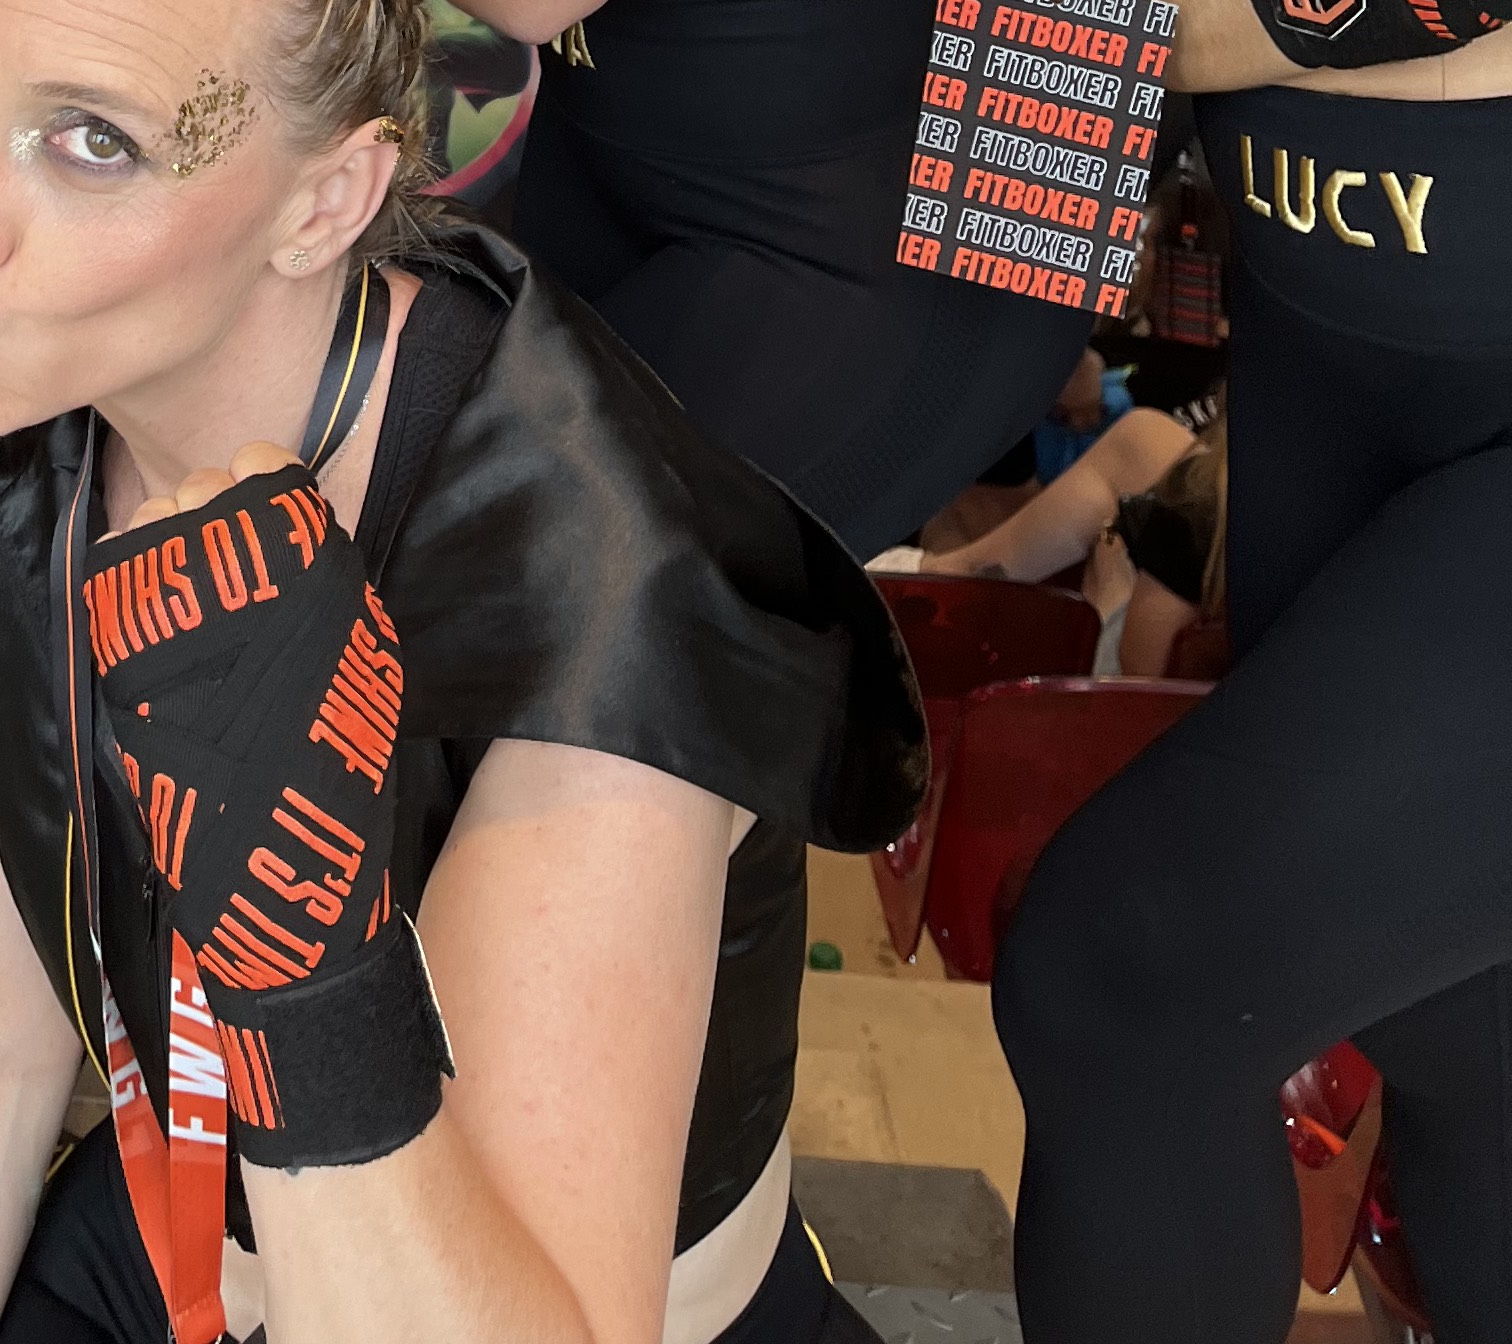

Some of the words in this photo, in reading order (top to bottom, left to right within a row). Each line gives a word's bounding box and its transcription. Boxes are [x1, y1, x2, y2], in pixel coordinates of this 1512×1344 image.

[990, 6, 1129, 67] FITBOXER
[983, 45, 1121, 108] FITBOXER
[977, 85, 1115, 149] FITBOXER
[970, 126, 1108, 192] FITBOXER
[963, 168, 1101, 231] FITBOXER
[1241, 134, 1433, 254] LUCY
[956, 207, 1093, 271] FITBOXER
[951, 248, 1086, 307] FITBOXER
[308, 618, 404, 795] SHINE
[247, 786, 365, 927] IT'S
